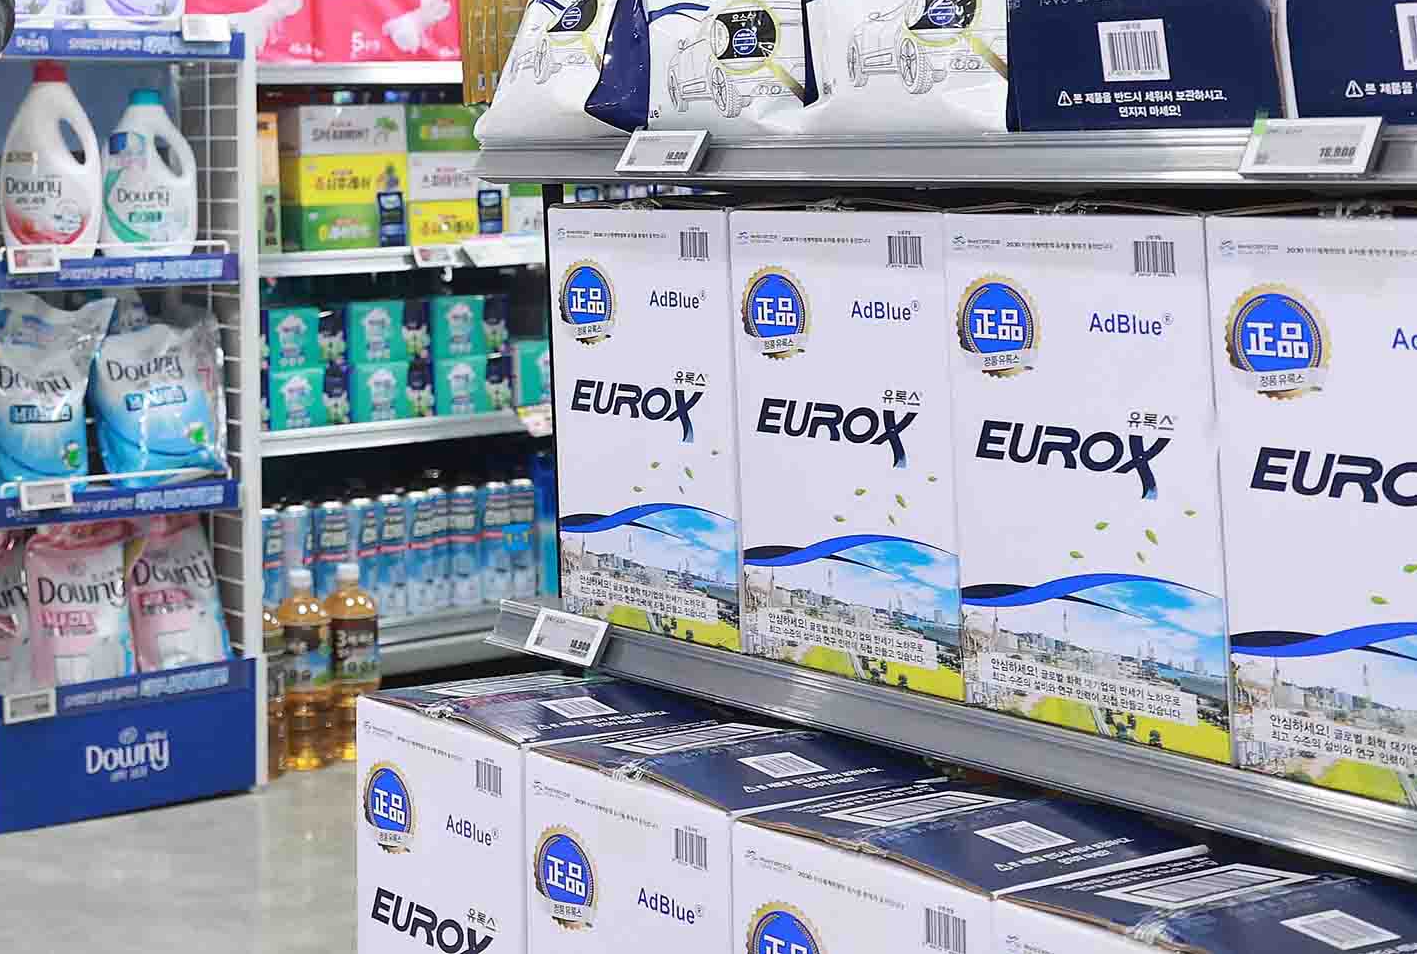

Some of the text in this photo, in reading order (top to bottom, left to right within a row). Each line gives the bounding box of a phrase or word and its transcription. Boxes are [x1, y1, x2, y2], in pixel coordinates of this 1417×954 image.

[1114, 91, 1143, 104] 반드시
[1119, 105, 1147, 117] 던지지
[5, 176, 62, 198] Downy
[117, 187, 170, 205] Downy
[571, 287, 605, 315] 正品
[755, 297, 797, 327] 正品
[973, 308, 1023, 342] 正品
[1246, 321, 1309, 359] 正品
[107, 352, 183, 382] Downy
[674, 370, 706, 387] 유록스
[571, 379, 704, 443] EUROX
[882, 389, 921, 407] 유록스
[757, 397, 919, 469] EUROX
[1128, 411, 1175, 431] 유록스
[976, 420, 1172, 501] EUROX
[1250, 447, 1417, 507] EURO
[132, 557, 216, 590] Downy
[38, 576, 128, 607] Downy
[991, 656, 1038, 678] 안심하세요!
[1269, 714, 1330, 739] 안심하세요!
[1334, 729, 1363, 745] 글로벌
[86, 739, 169, 775] Downy
[373, 788, 406, 825] 正品
[547, 854, 586, 897] 正品
[371, 886, 494, 954] EUROX
[467, 908, 497, 932] 유록스
